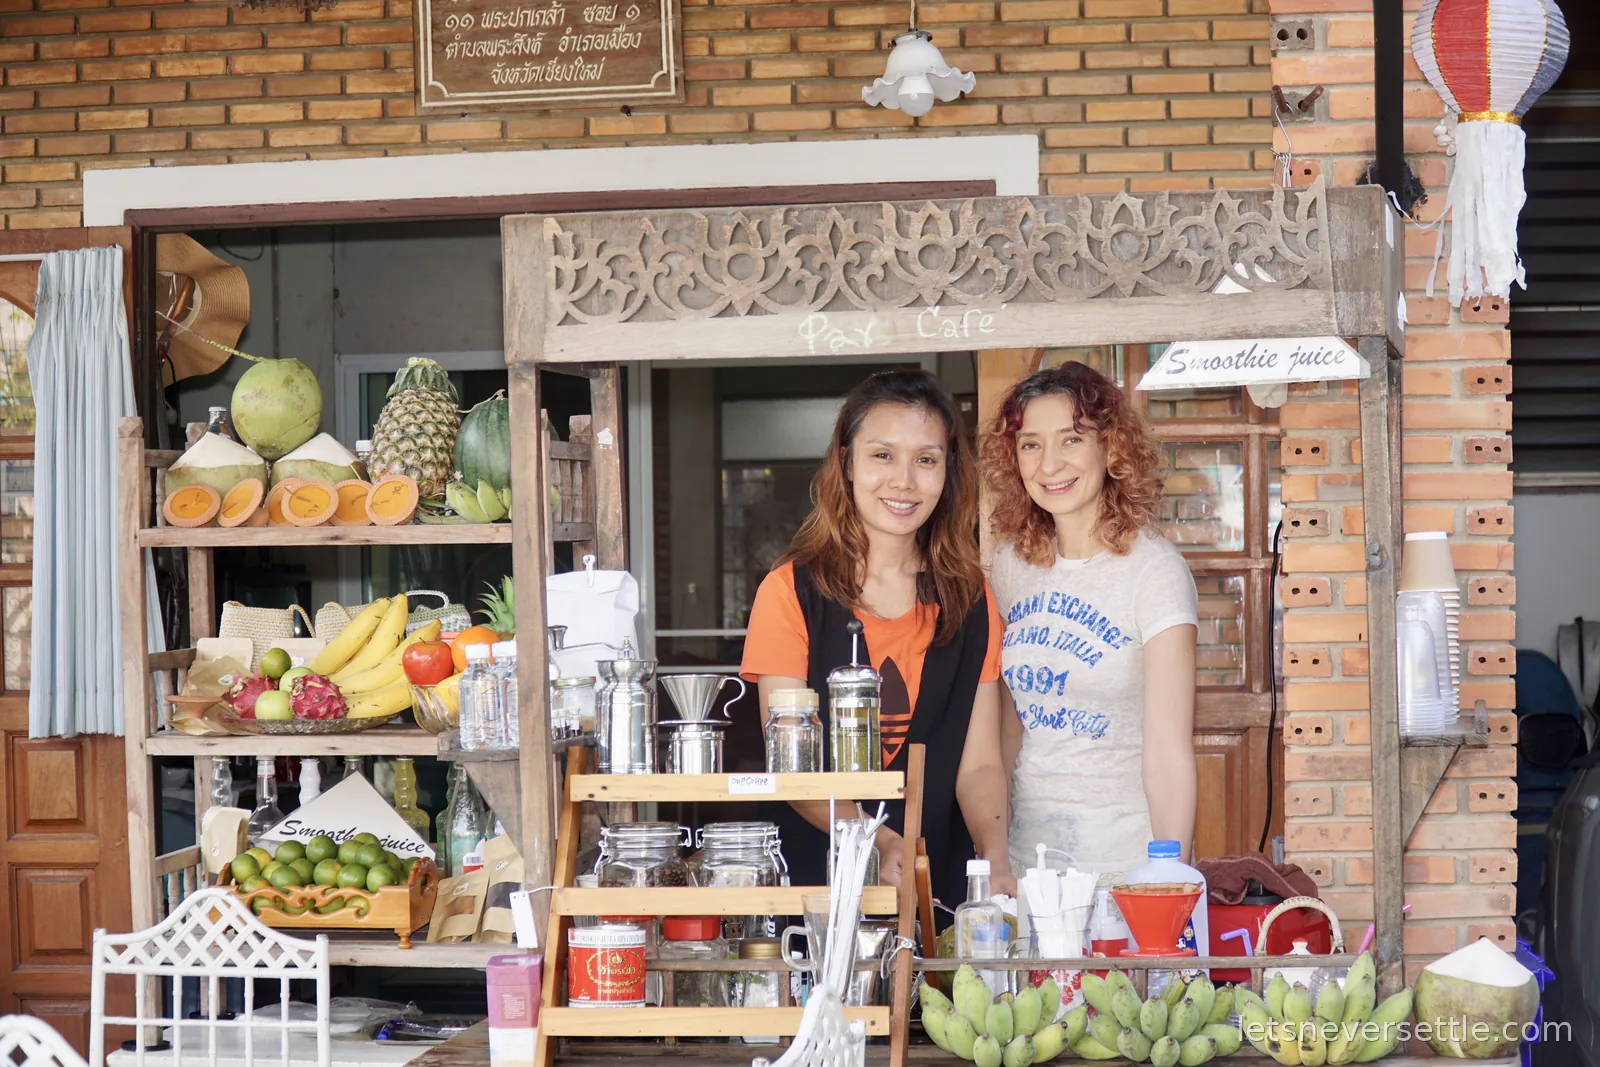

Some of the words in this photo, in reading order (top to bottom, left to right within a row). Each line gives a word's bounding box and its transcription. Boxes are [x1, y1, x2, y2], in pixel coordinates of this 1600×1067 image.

[481, 1, 566, 29] พระปกเกล้า
[584, 5, 617, 24] ซอย
[558, 25, 643, 53] อำเภอเมือง
[490, 56, 607, 85] จังหวัดเชียงใหม่
[1166, 343, 1278, 375] Smoothie
[1287, 345, 1346, 375] juice
[1052, 630, 1104, 669] ITALIA
[1004, 664, 1070, 696] 1991
[1029, 703, 1068, 730] York
[381, 834, 425, 853] juice
